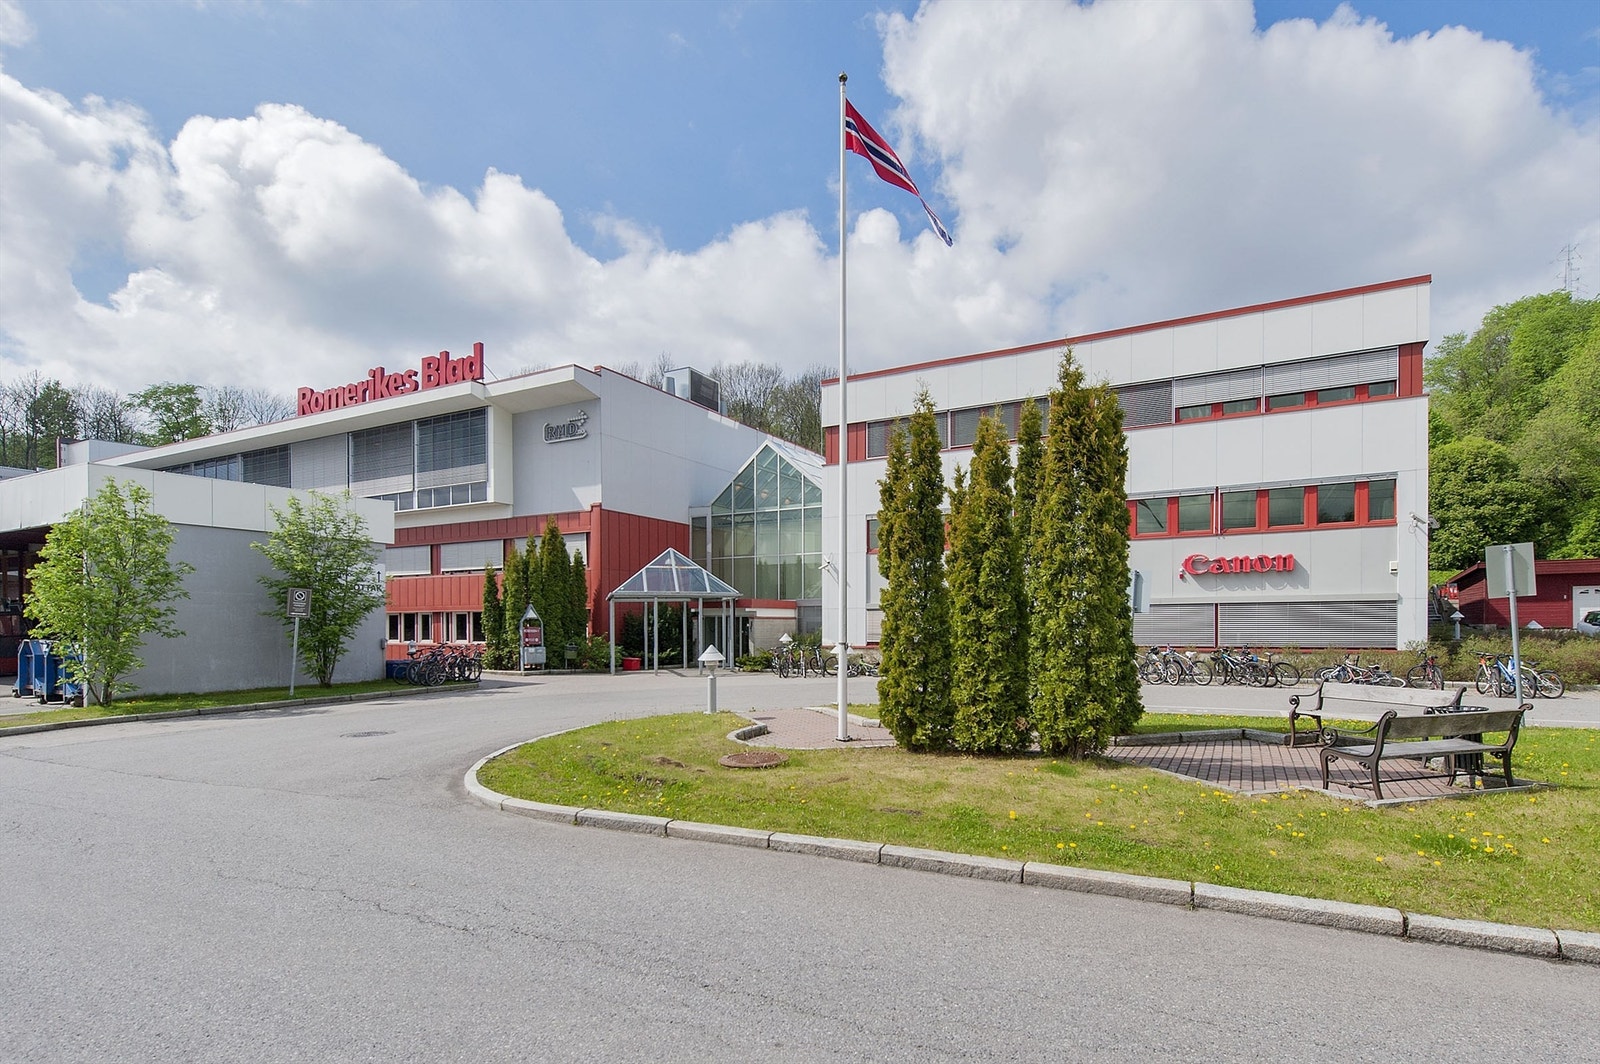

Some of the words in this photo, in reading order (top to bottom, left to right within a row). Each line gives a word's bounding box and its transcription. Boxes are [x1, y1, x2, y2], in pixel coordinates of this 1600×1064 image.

[298, 367, 418, 416] Romerikes
[421, 342, 484, 390] Blad
[1181, 553, 1295, 575] Canon
